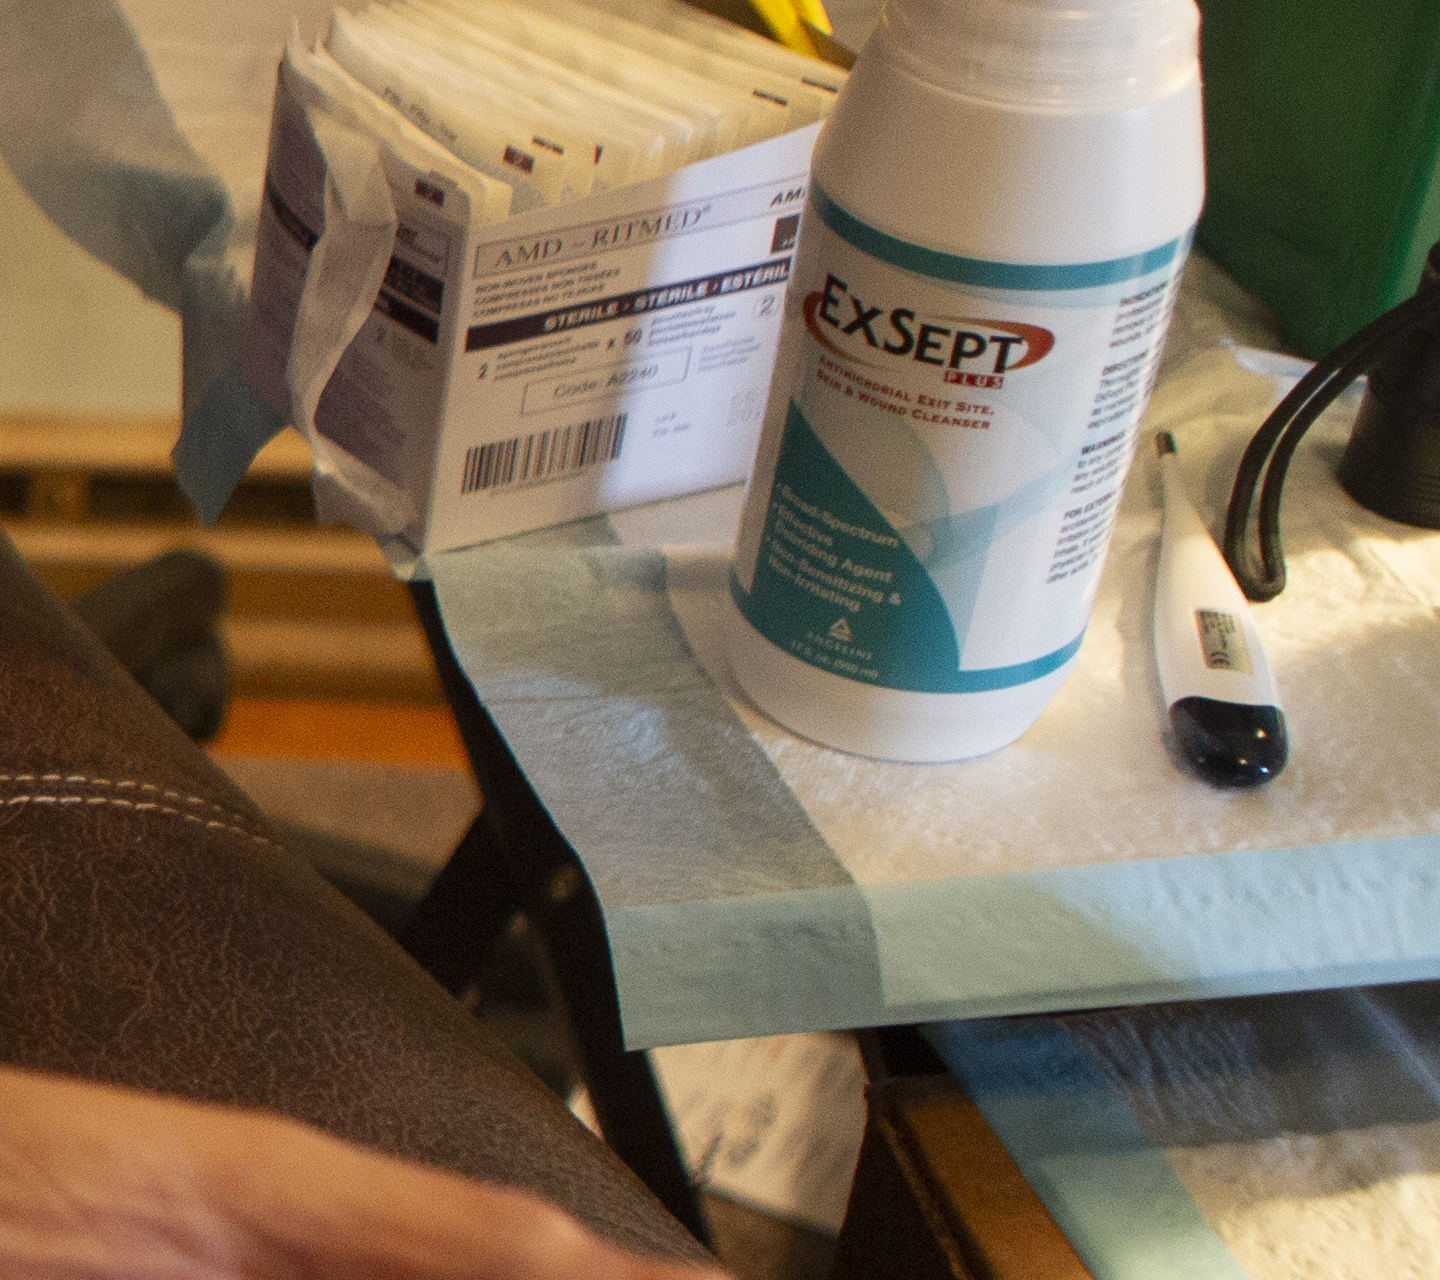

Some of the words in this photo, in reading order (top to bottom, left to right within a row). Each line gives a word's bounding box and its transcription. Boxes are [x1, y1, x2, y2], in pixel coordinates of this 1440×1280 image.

[496, 238, 564, 269] AMD
[544, 298, 620, 332] STERILE
[945, 372, 1004, 389] PLUS
[857, 391, 908, 417] WOUND
[912, 408, 991, 429] CLEANSER
[842, 559, 894, 584] Agent
